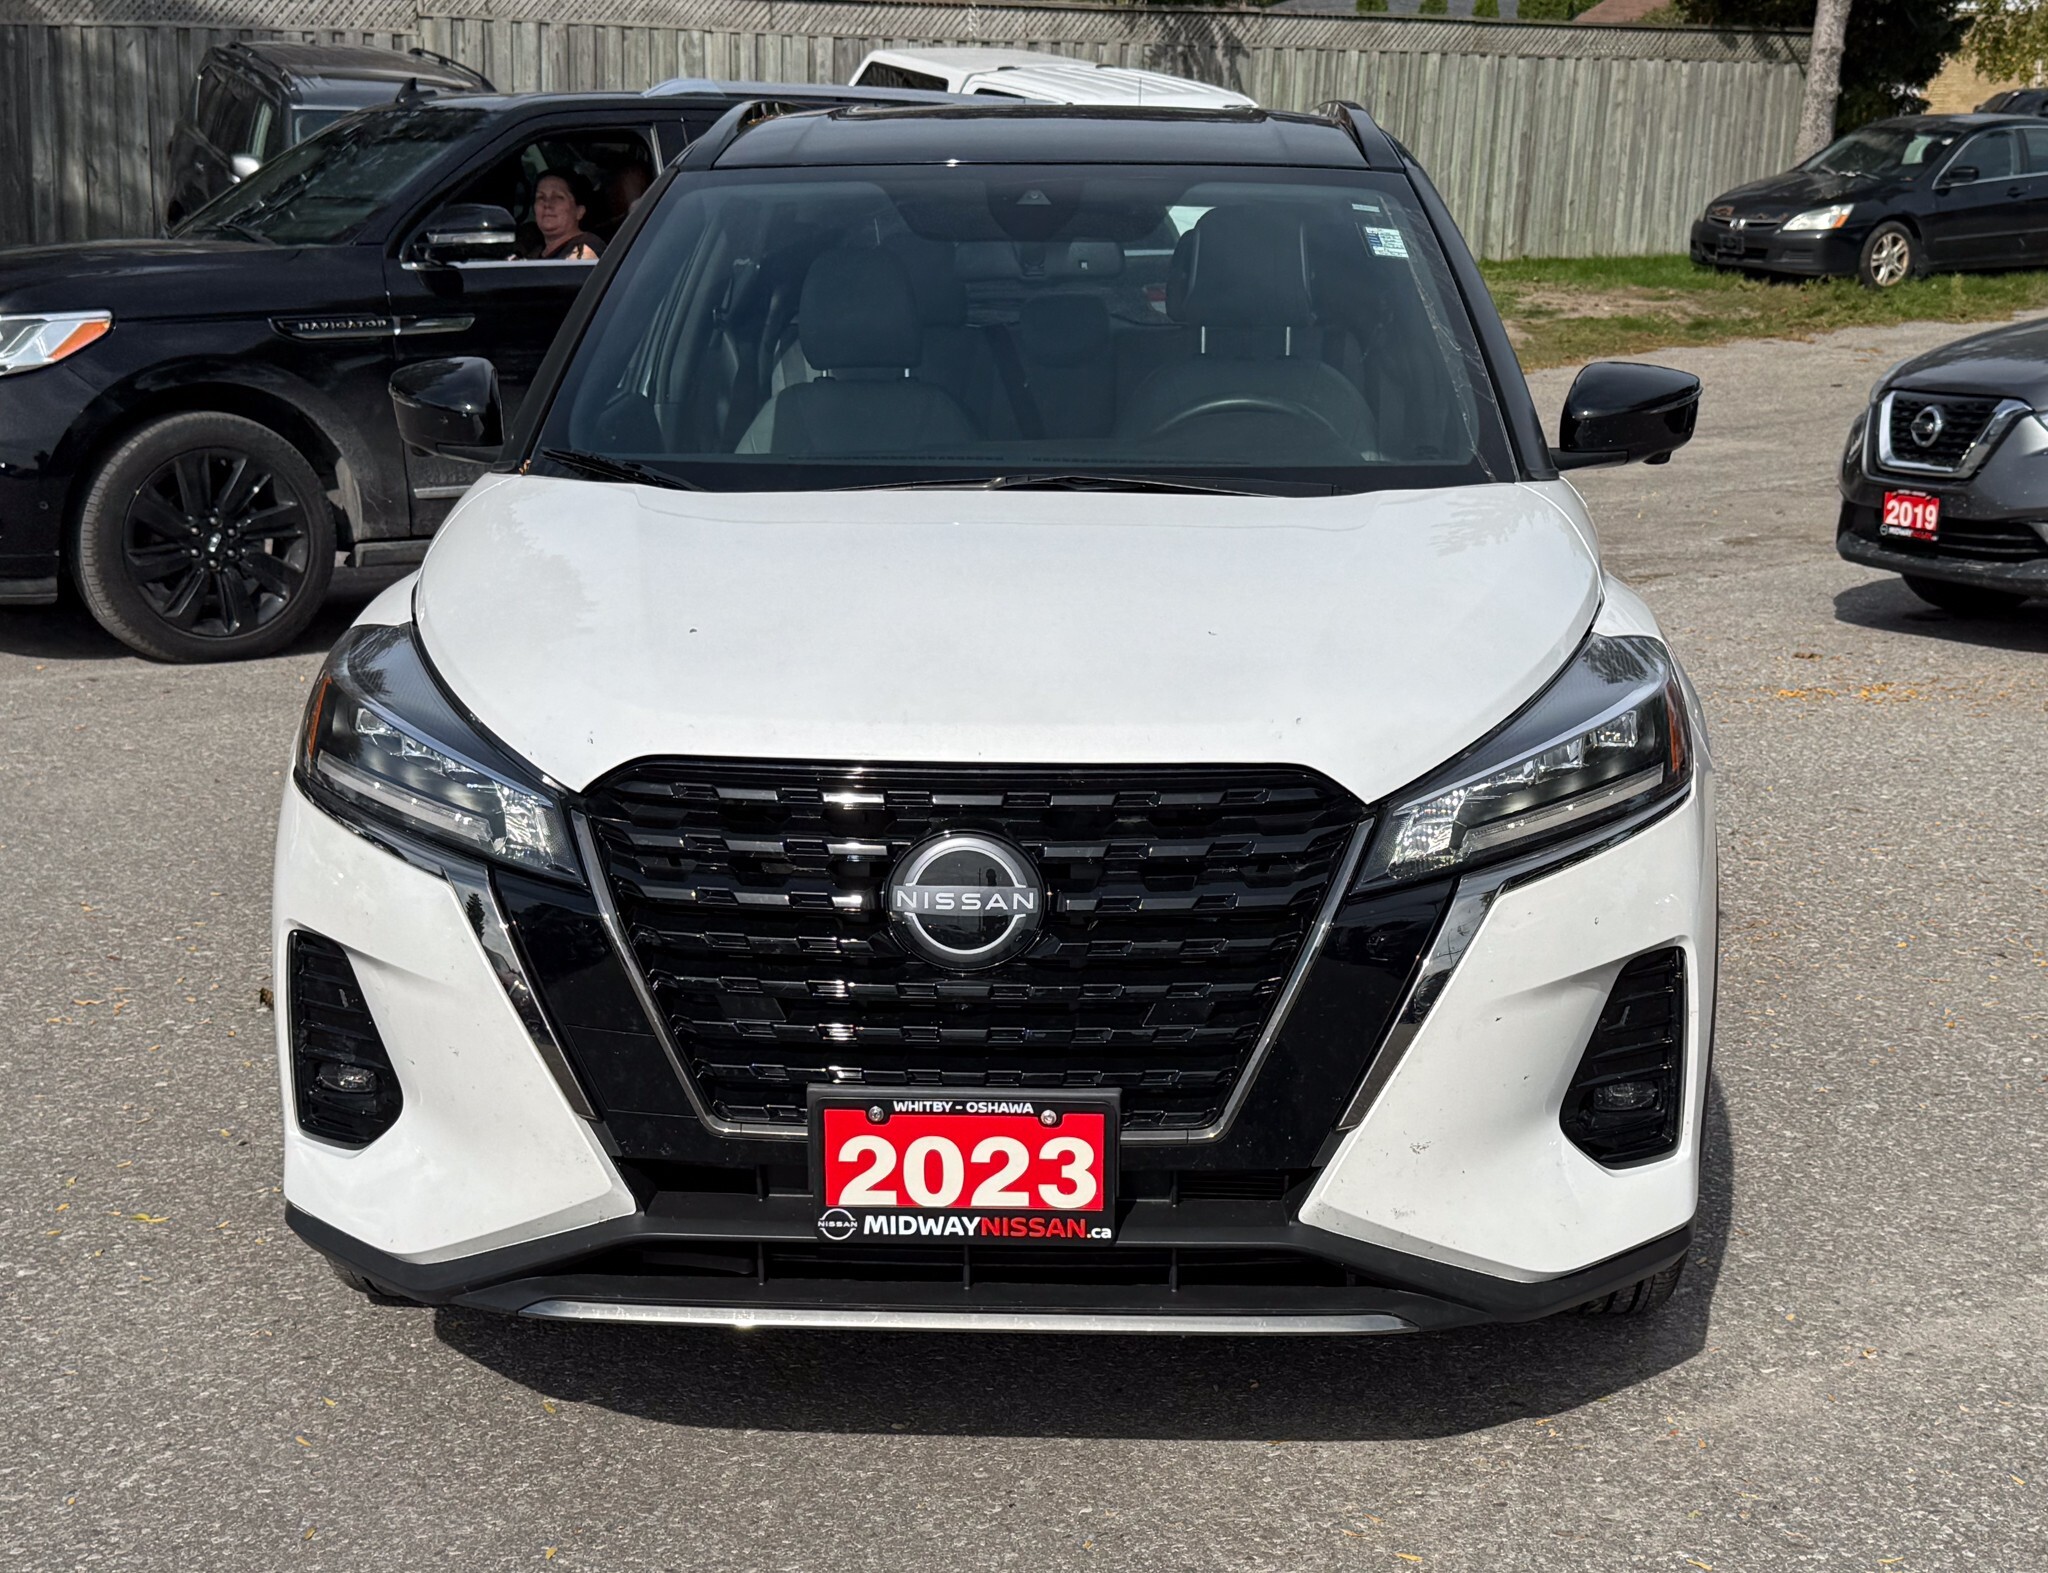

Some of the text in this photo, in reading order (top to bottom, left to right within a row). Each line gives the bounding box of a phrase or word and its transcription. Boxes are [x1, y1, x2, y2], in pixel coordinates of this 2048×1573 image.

[298, 318, 387, 331] NAVIGATOR
[1885, 499, 1937, 530] 2019
[896, 890, 1034, 910] NISSAN
[893, 1101, 953, 1113] WHITBY
[966, 1102, 1035, 1115] OSHAWA
[838, 1134, 1097, 1209] 2023
